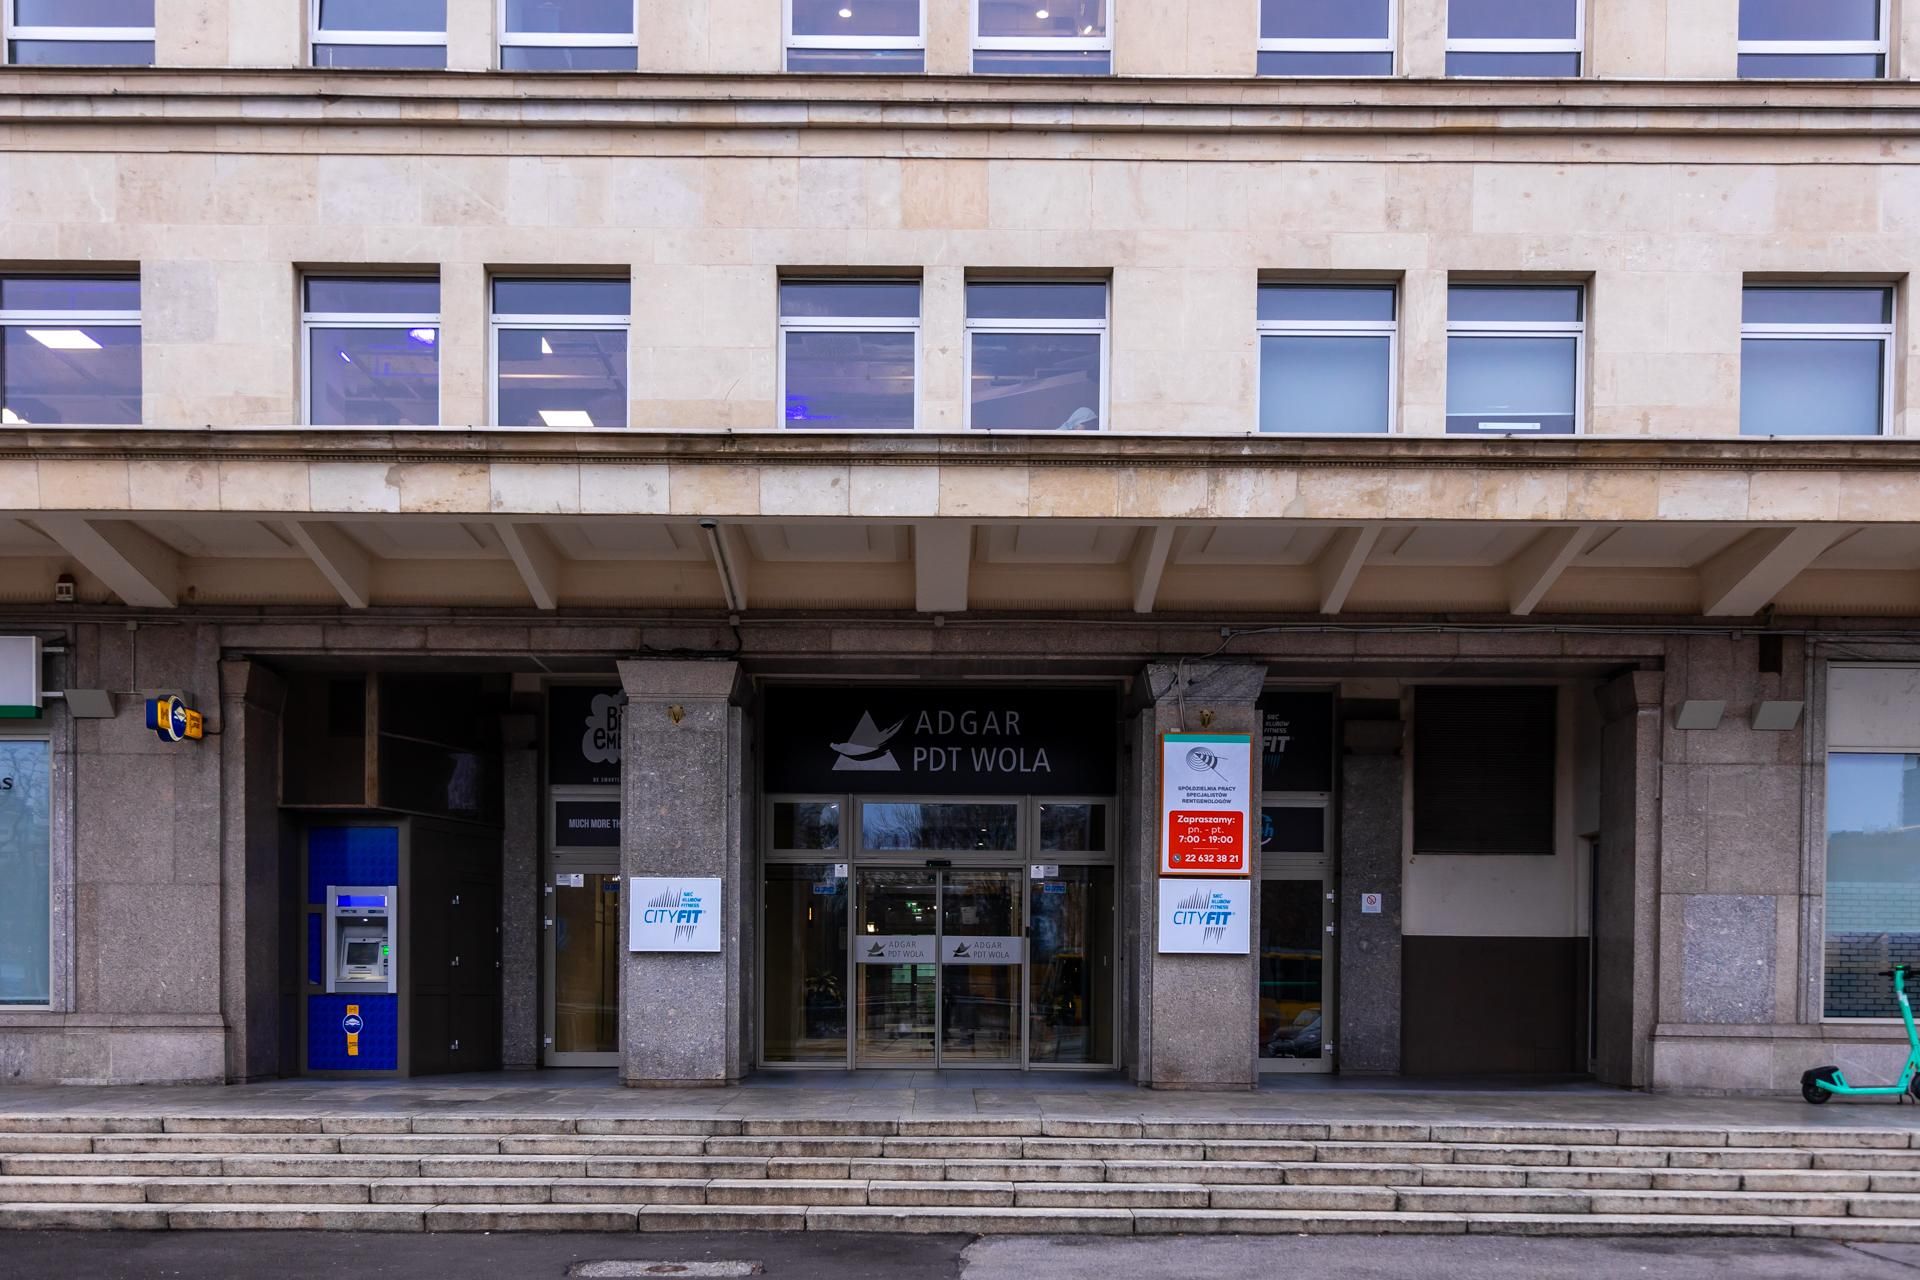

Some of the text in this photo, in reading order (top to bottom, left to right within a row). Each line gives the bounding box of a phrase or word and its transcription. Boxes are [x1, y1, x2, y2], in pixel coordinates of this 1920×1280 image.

[915, 710, 1021, 735] ADGAR
[912, 747, 1051, 773] PDT WOLA
[568, 818, 590, 829] MUCH
[590, 818, 612, 829] MORE
[1177, 815, 1236, 826] Zapraszamy:
[1187, 826, 1203, 835] pn.
[1211, 826, 1225, 835] pt.
[1178, 835, 1200, 843] 7:00
[1208, 835, 1234, 844] 19:00
[1185, 854, 1239, 863] 22 632 38 21
[644, 909, 703, 924] CITYFIT
[1173, 911, 1232, 926] CITYFIT
[888, 940, 917, 948] ADGAR
[974, 941, 1002, 949] ADGAR
[887, 950, 924, 958] PDT WOLA
[973, 950, 1010, 959] PDT WOLA
